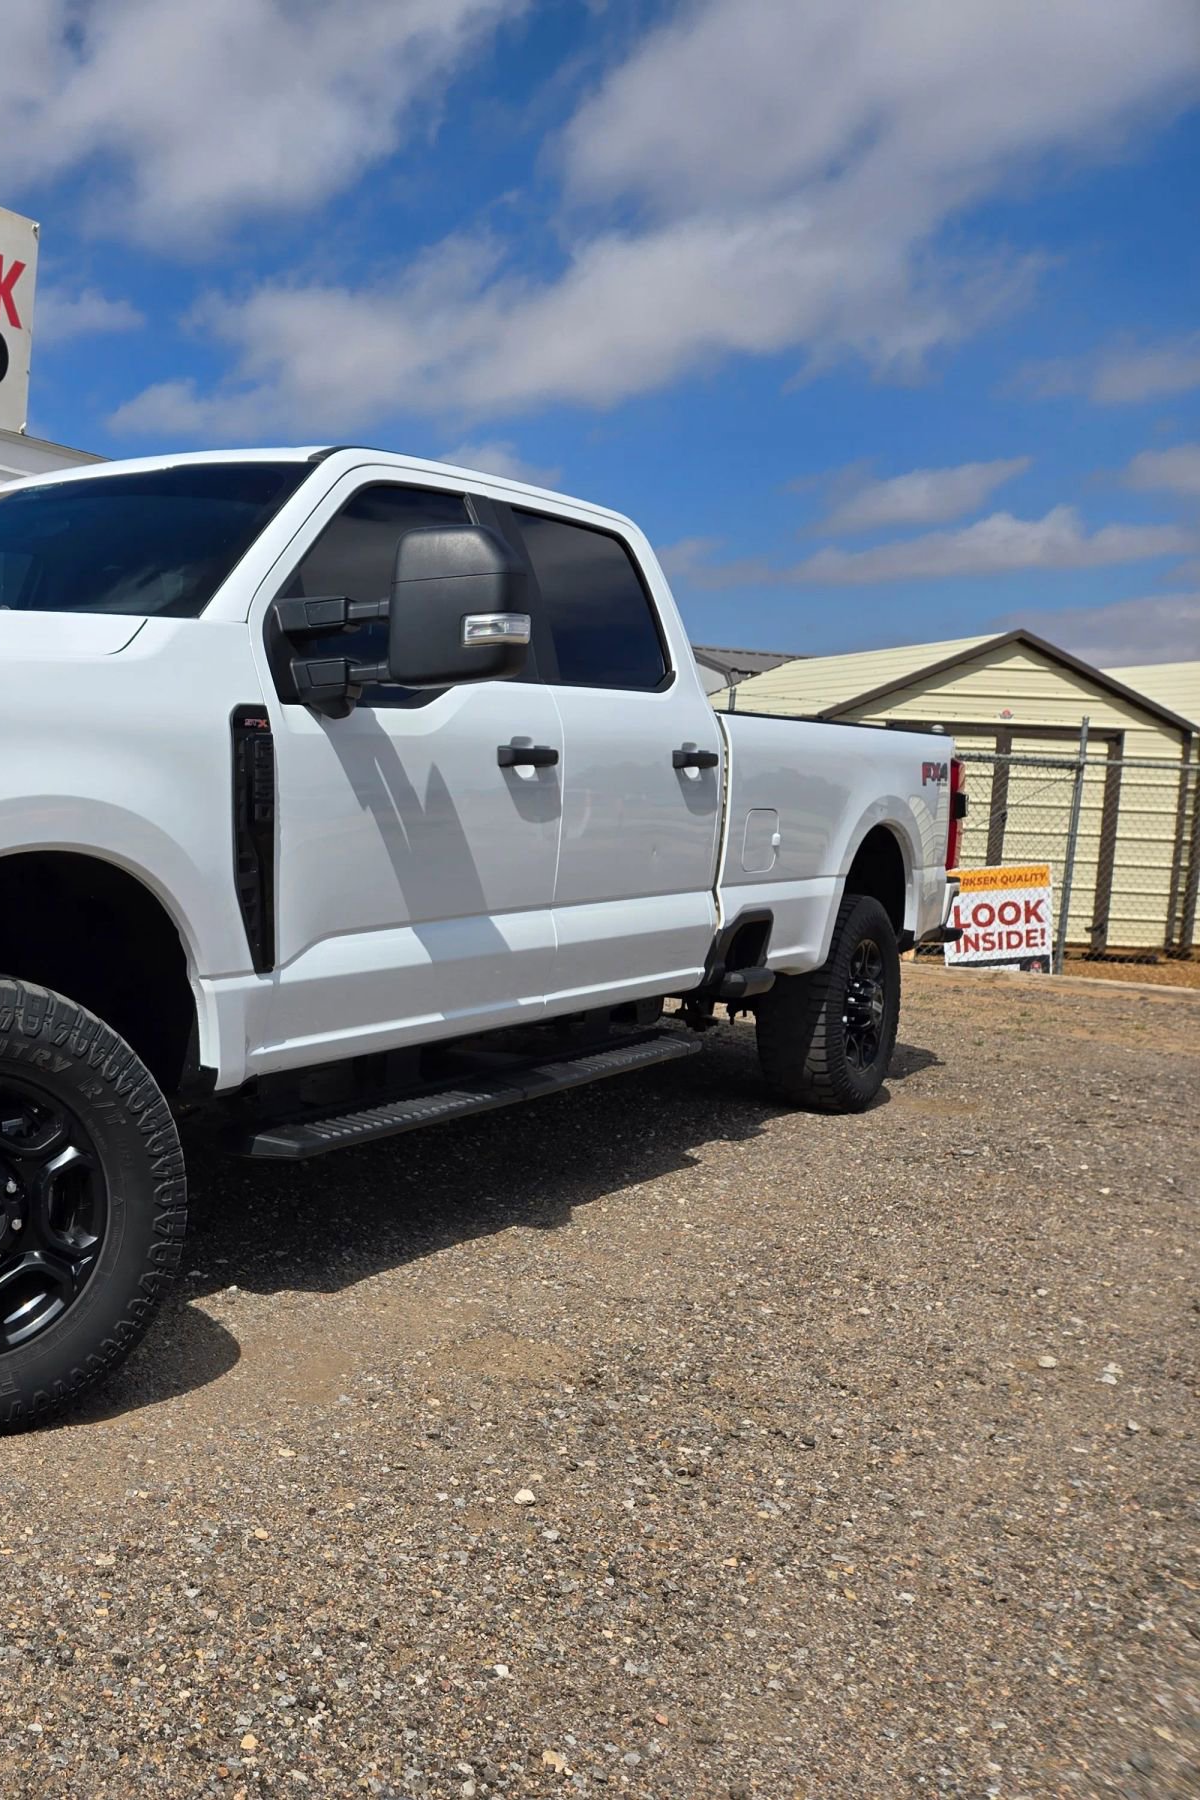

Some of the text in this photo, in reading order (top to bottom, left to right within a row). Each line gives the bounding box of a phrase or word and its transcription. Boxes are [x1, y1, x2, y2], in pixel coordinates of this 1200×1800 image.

[921, 761, 948, 787] FX4
[961, 872, 1046, 887] RKSEN QUALITY
[953, 898, 1045, 929] LOOK
[955, 928, 1046, 954] INSIDE!
